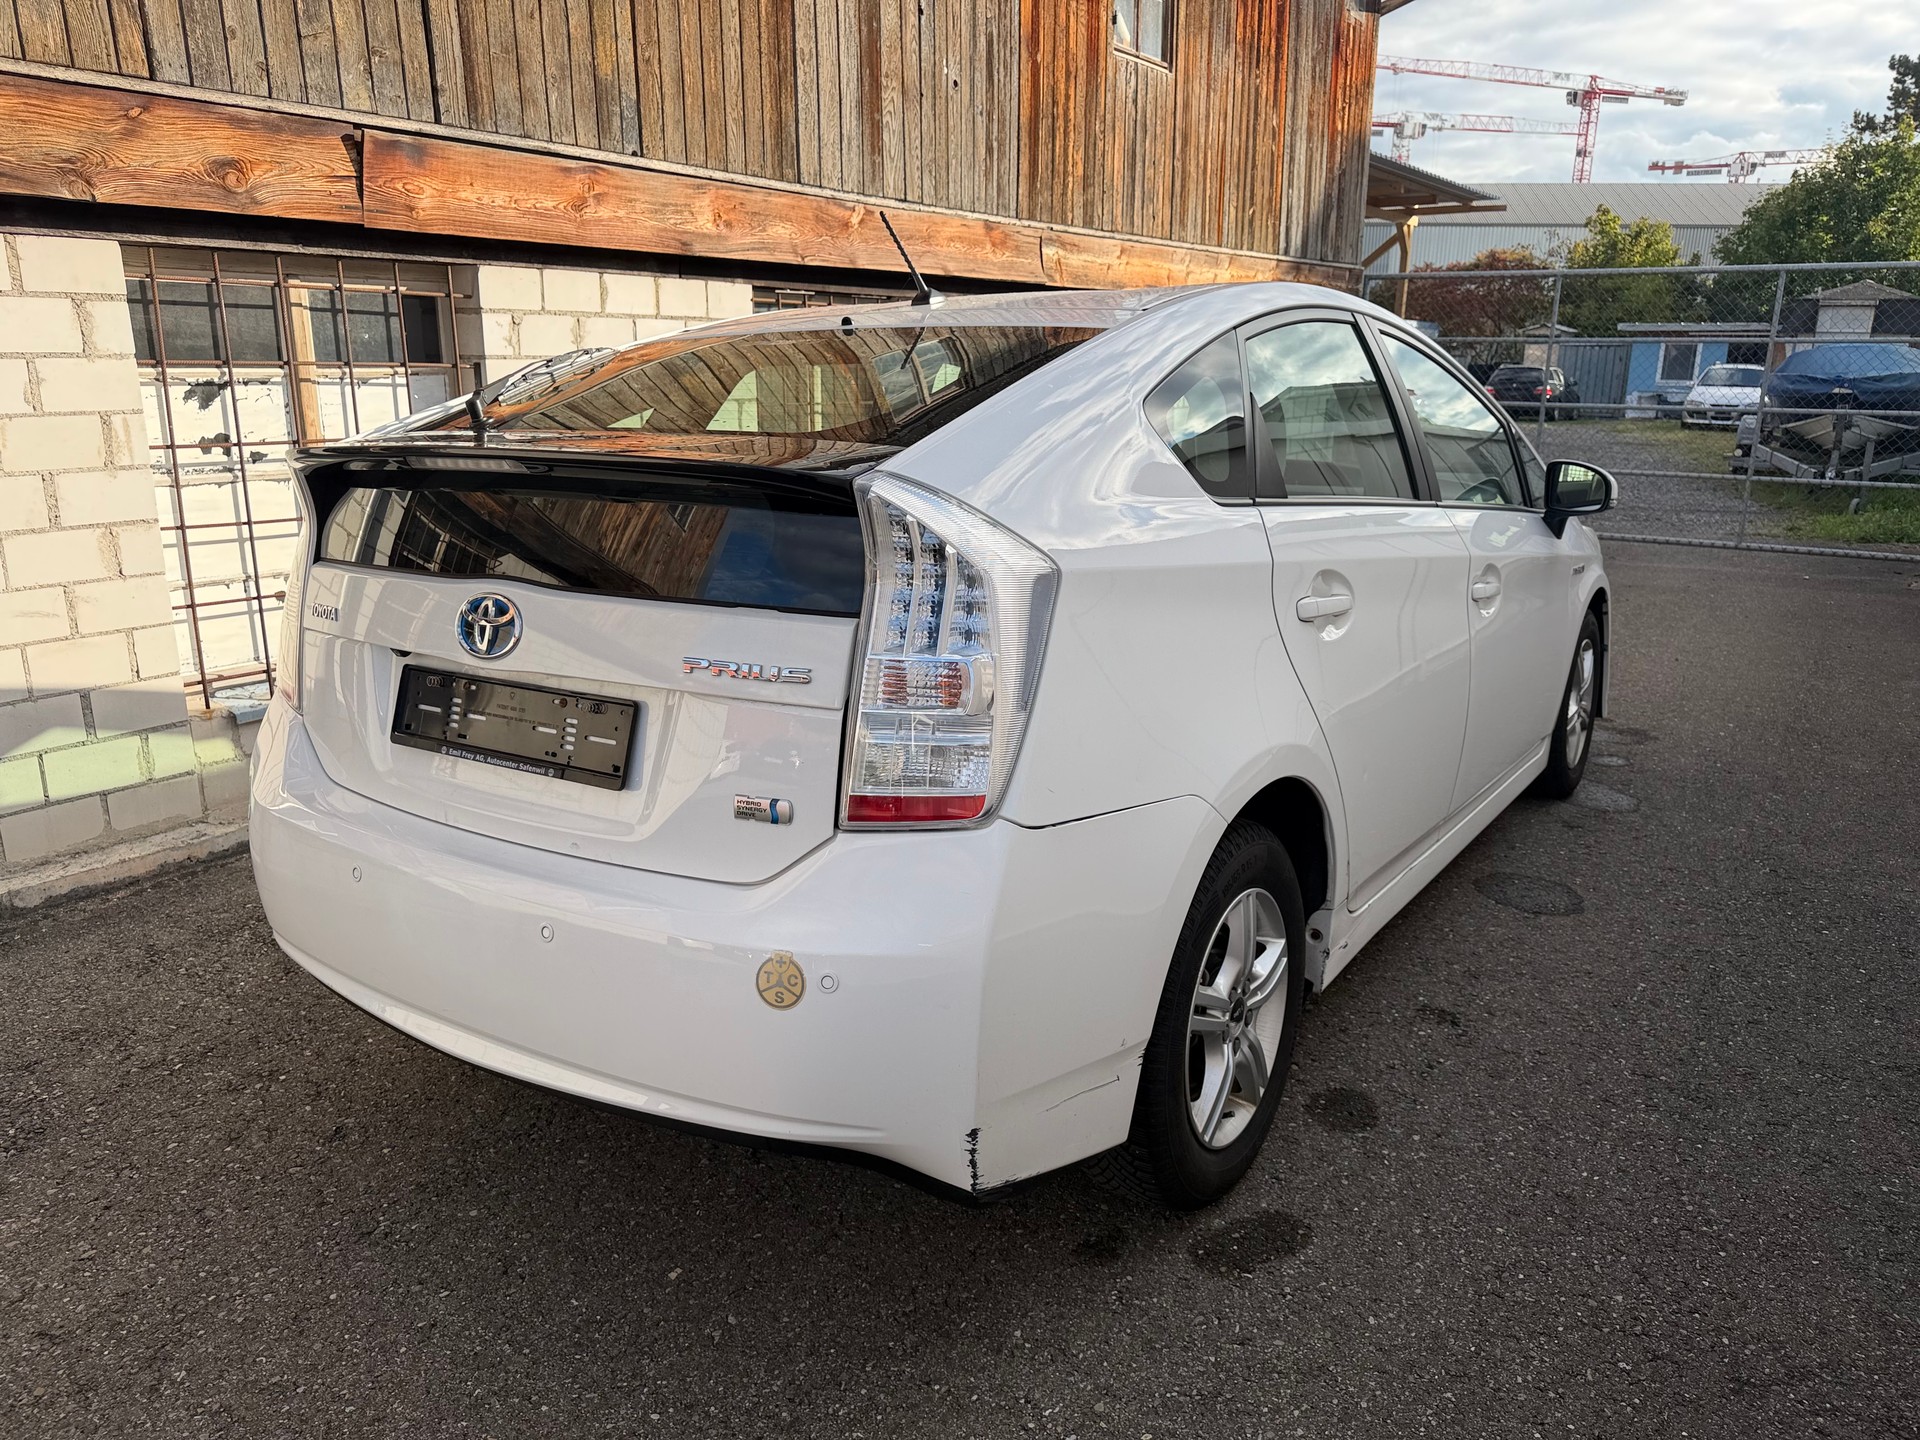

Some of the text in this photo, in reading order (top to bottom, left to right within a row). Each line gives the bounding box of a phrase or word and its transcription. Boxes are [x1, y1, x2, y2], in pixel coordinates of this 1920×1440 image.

[682, 656, 812, 685] PRIUS
[449, 748, 546, 774] Emil Frey AG, Autocenter Safenwil
[736, 799, 762, 807] HYBRID
[736, 805, 768, 813] SYNERGY
